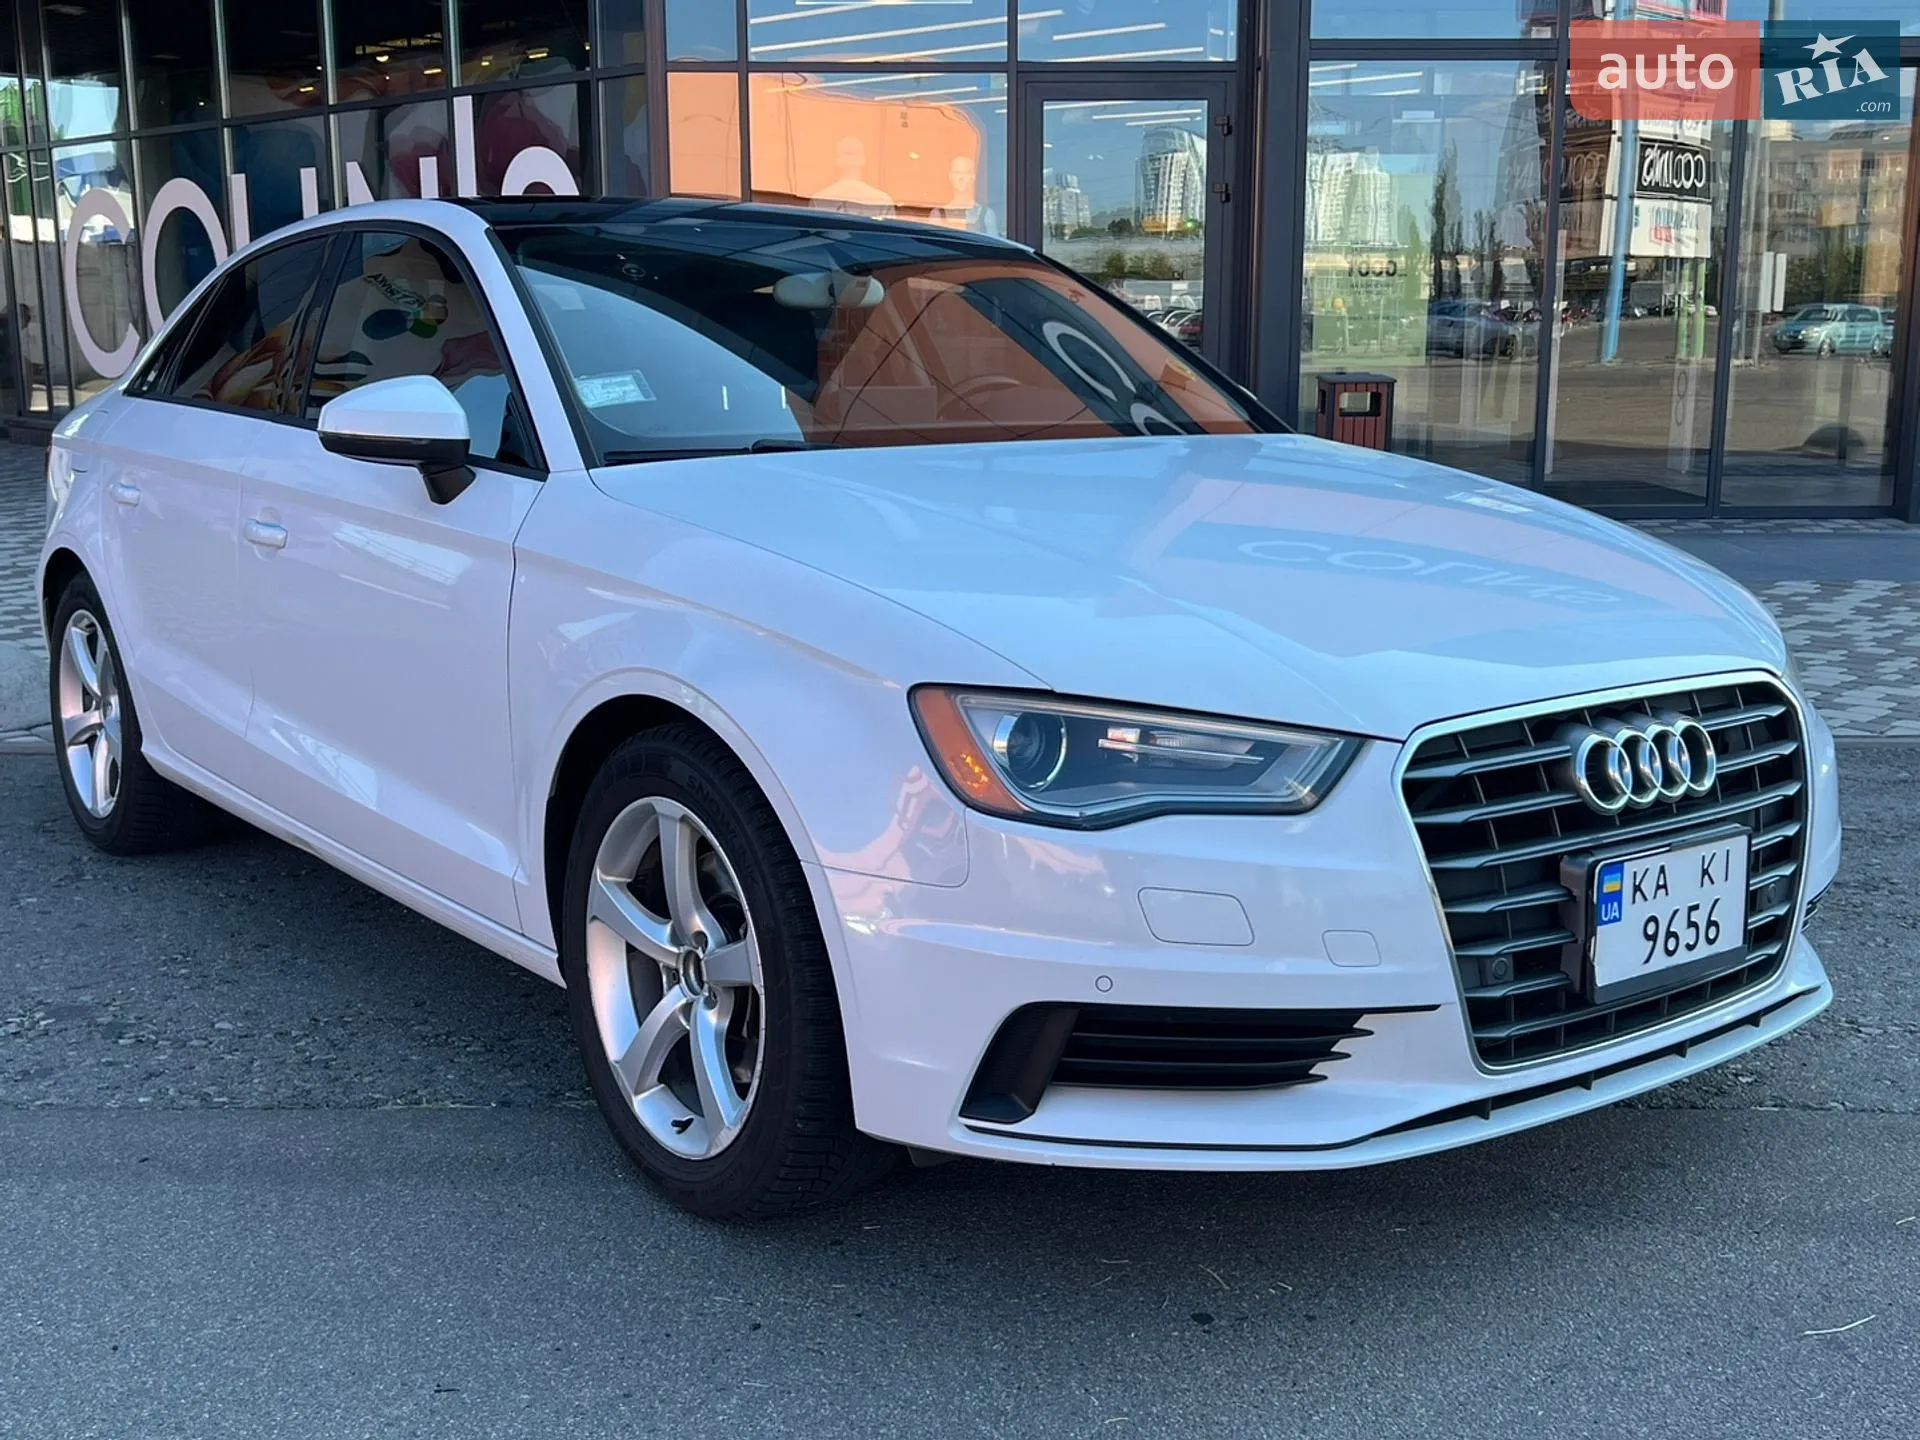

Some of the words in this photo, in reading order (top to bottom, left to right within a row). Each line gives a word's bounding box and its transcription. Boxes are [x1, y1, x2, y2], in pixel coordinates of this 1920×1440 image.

[1632, 864, 1669, 905] KA
[1701, 849, 1730, 888] KI
[1601, 902, 1620, 921] UA
[1643, 898, 1720, 965] 9656
